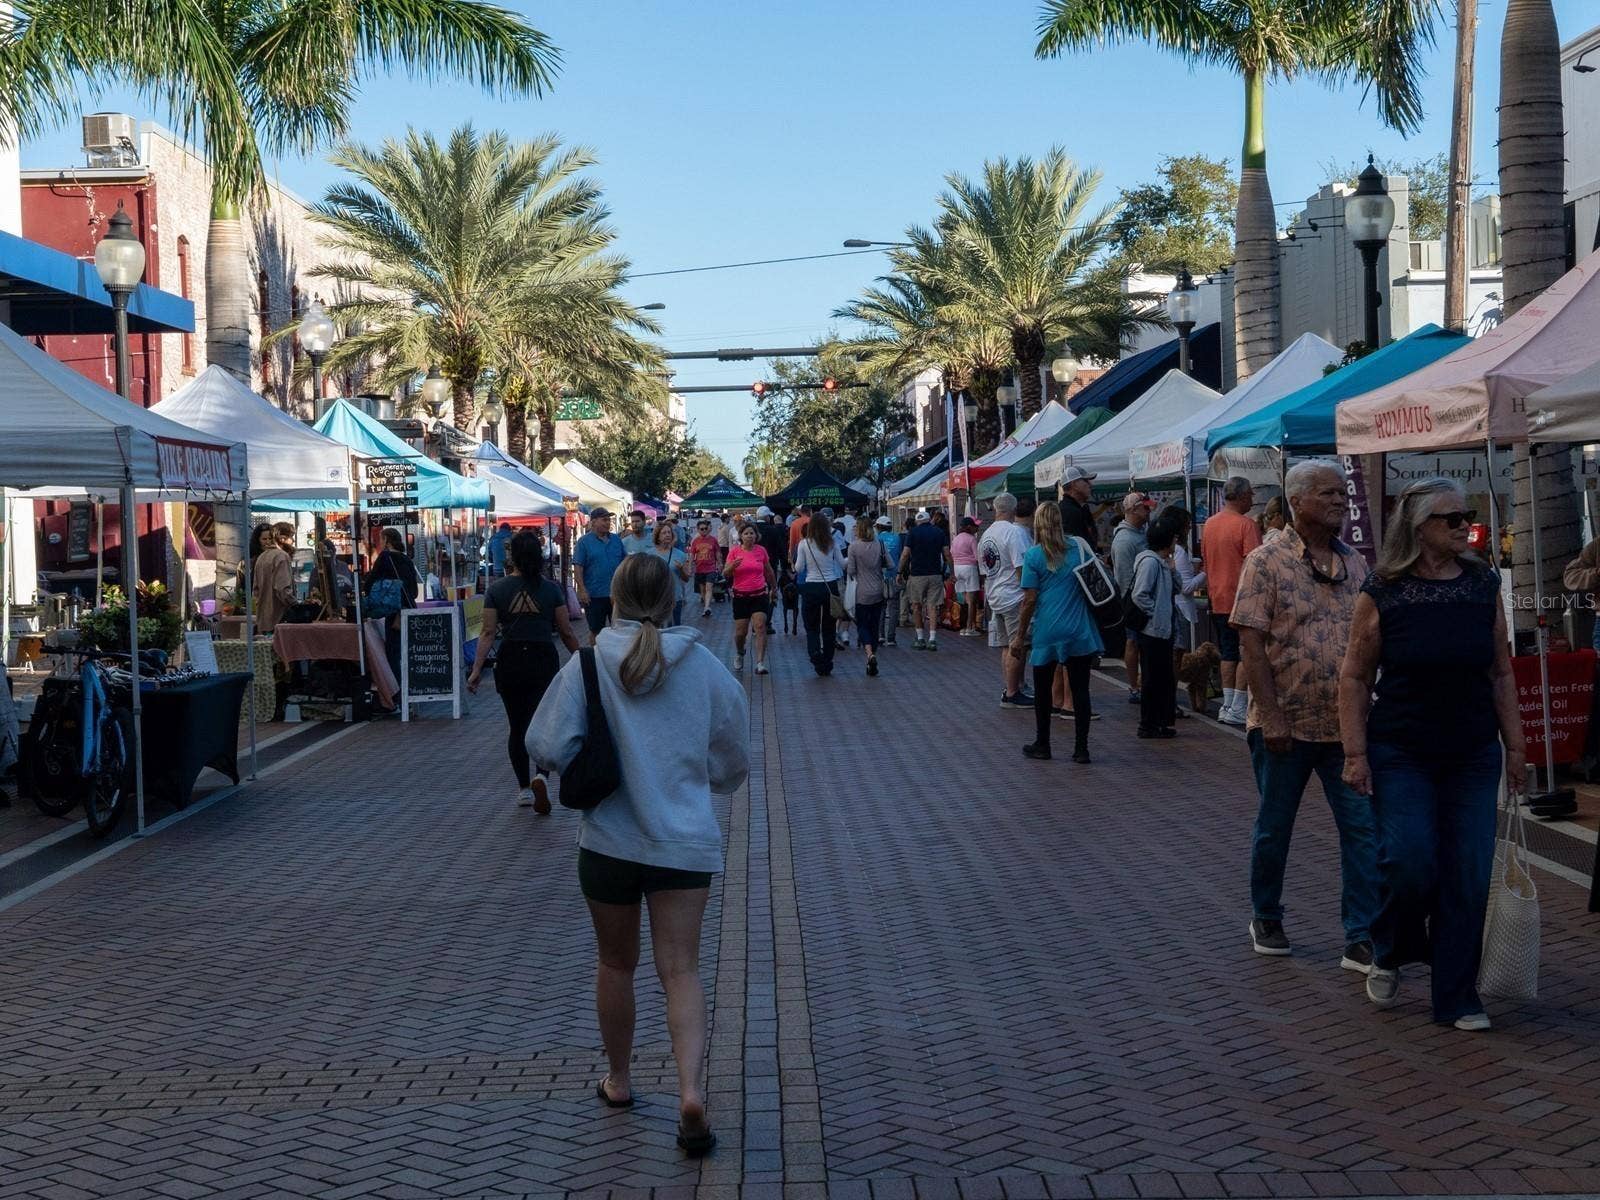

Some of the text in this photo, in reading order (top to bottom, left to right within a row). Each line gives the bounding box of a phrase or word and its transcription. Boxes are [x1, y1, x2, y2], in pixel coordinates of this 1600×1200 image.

[1375, 405, 1433, 439] HUMMUS
[158, 442, 229, 484] BIKE REPAIRS
[1386, 457, 1482, 482] Sourdough
[367, 464, 417, 478] Regeneratively
[370, 483, 412, 492] turmeric
[371, 499, 382, 507] FL
[1343, 455, 1363, 542] Baba
[1531, 684, 1568, 695] Glten
[1518, 699, 1568, 713] Adde Oil
